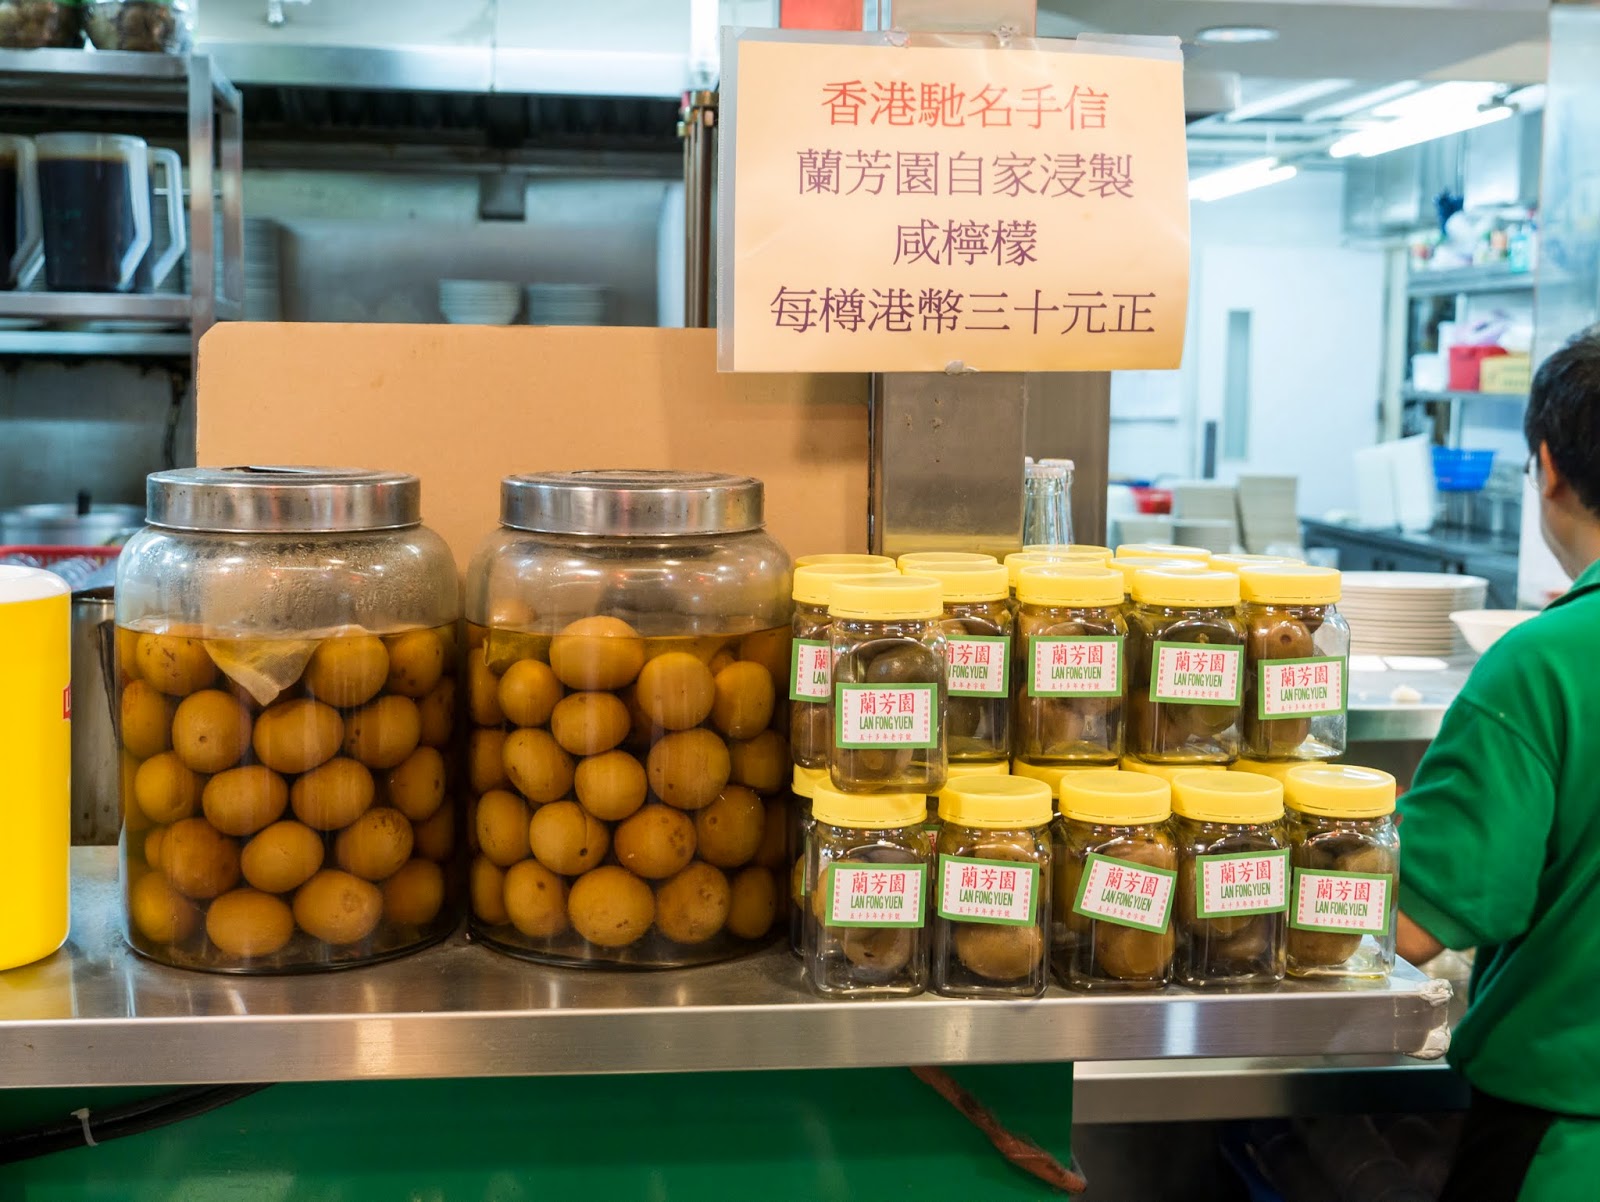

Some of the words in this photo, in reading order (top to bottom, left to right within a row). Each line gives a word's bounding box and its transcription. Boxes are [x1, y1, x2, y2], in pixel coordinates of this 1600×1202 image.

[821, 80, 1109, 131] 香港馳名手信
[797, 149, 1135, 199] 蘭芳園自家浸製
[893, 218, 1038, 267] 咸檸檬
[770, 286, 1157, 335] 每樽港幣三十元正
[1052, 644, 1103, 666] 蘭芳園
[1175, 651, 1225, 673] 蘭芳園
[952, 665, 970, 679] FONG
[970, 666, 988, 679] YUEN
[1051, 666, 1065, 680] LAN
[1066, 666, 1083, 680] FONG
[1083, 666, 1102, 680] YUEN
[1174, 672, 1187, 686] LAN
[1187, 673, 1205, 687] FONG
[1205, 674, 1223, 688] YUEN
[1281, 665, 1328, 687] 蘭芳園
[860, 691, 915, 715] 蘭芳園
[1281, 689, 1294, 702] LAN
[1294, 687, 1311, 701] FONG
[1311, 686, 1328, 700] YUEN
[859, 715, 874, 730] LAN
[875, 715, 894, 730] FONG
[894, 715, 914, 730] YUEN
[852, 871, 906, 894] 蘭芳園
[961, 865, 1017, 892] 蘭芳園
[1105, 867, 1159, 897] 蘭芳園
[1220, 860, 1271, 884] 蘭芳園
[959, 888, 974, 903] LAN
[974, 890, 993, 905] FONG
[994, 891, 1014, 906] YUEN
[1101, 888, 1116, 904] LAN
[1115, 892, 1134, 909] FONG
[1133, 894, 1153, 912] YUEN
[1220, 885, 1235, 899] LAN
[1235, 883, 1252, 898] FONG
[1252, 882, 1271, 896] YUEN
[1317, 878, 1370, 902] 蘭芳園
[850, 895, 865, 909] LAN
[866, 895, 884, 909] FONG
[885, 895, 904, 909] YUEN
[1315, 900, 1330, 914] LAN
[1330, 901, 1348, 916] FONG
[1348, 902, 1368, 917] YUEN
